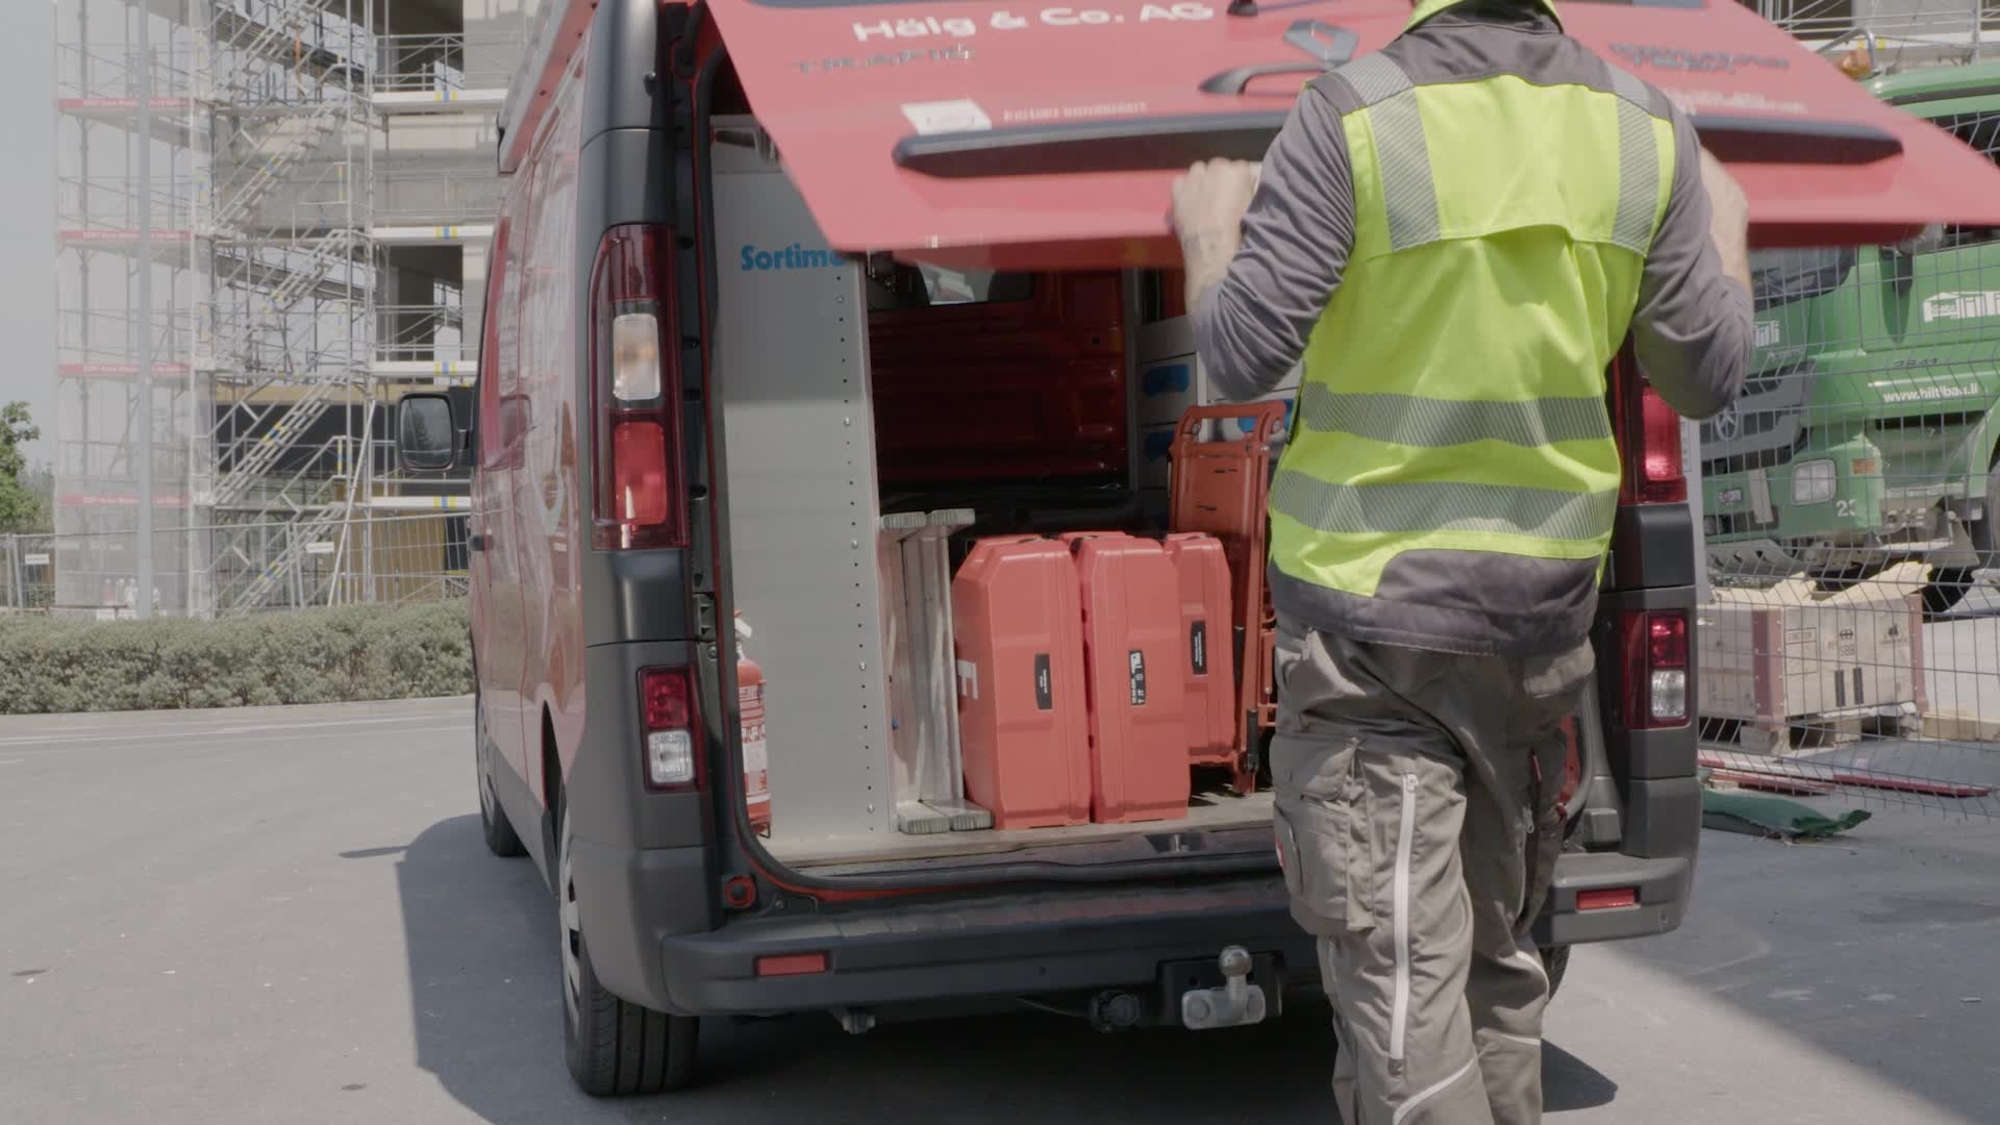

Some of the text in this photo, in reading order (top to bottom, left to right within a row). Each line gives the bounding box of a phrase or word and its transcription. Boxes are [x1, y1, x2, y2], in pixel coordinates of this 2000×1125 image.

[852, 2, 1214, 42] Hälg & Co. AG
